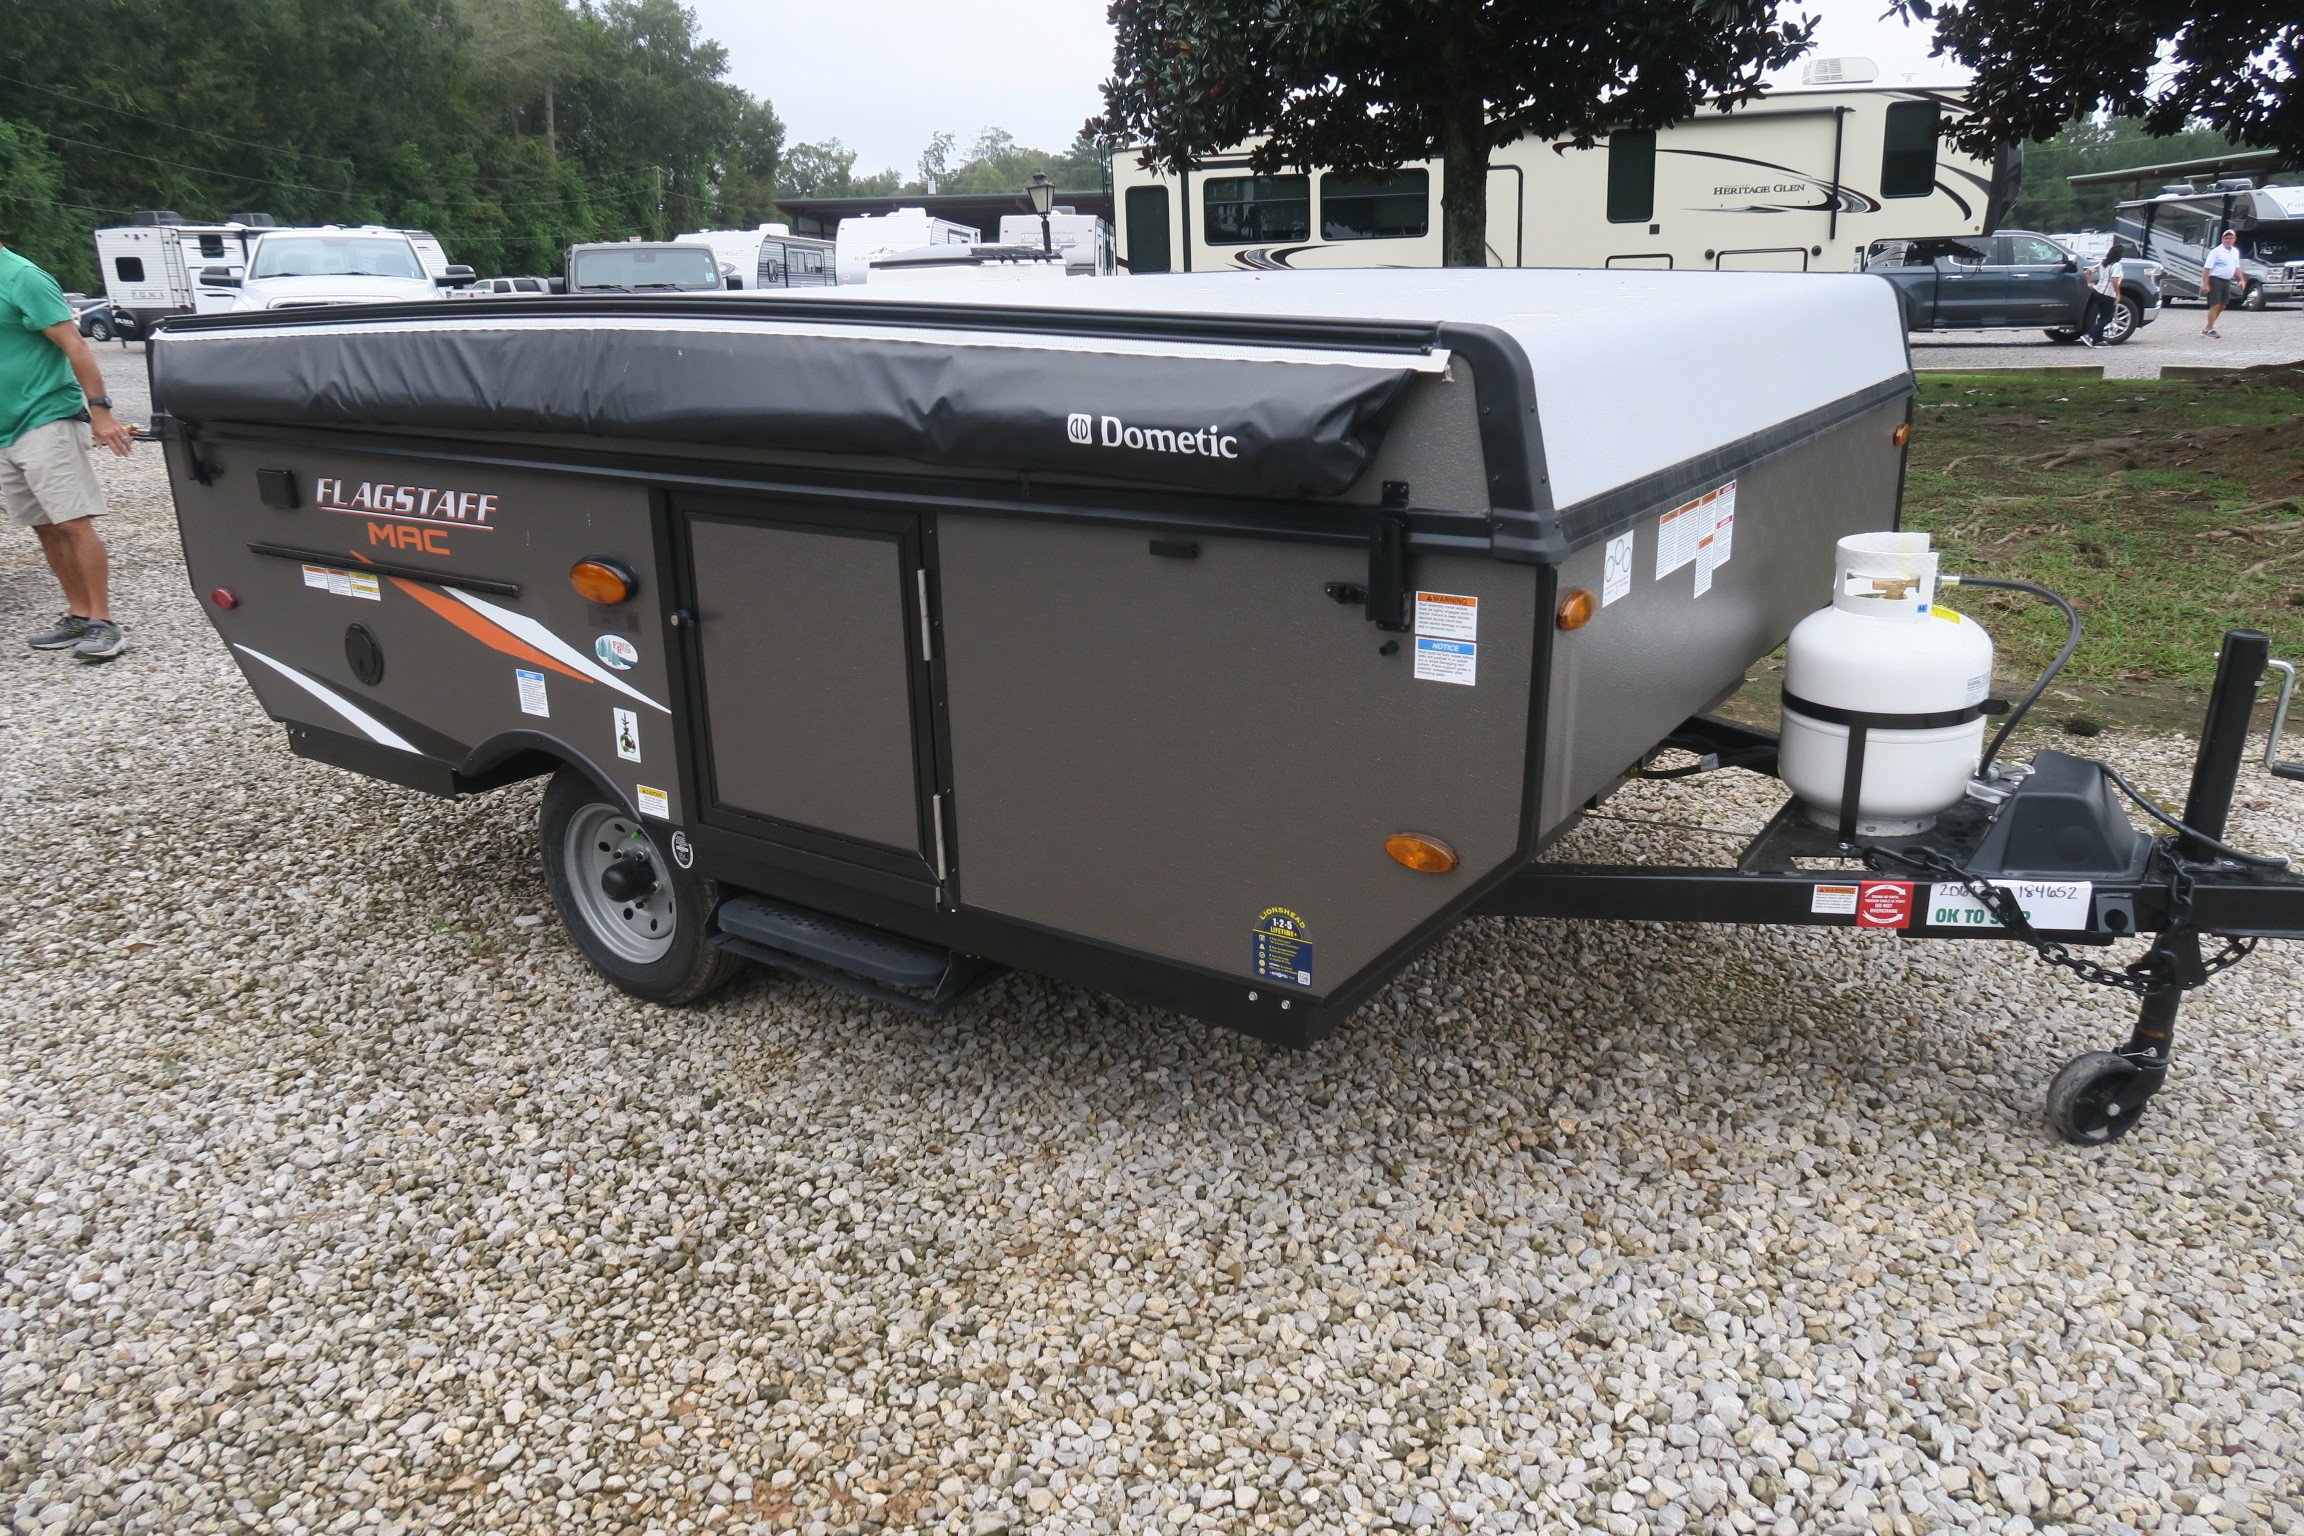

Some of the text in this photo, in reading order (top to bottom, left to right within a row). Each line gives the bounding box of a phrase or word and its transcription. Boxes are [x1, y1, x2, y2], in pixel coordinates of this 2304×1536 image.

[1713, 185, 1770, 195] HERITAGE
[1773, 184, 1805, 192] GLEN
[1101, 415, 1238, 459] Dometic
[316, 477, 498, 522] FLAGSTAFF
[367, 521, 450, 555] MAC
[1432, 642, 1460, 651] NOTICE
[2019, 885, 2078, 899] 184652
[1260, 907, 1305, 929] LIONSHEAD
[1935, 908, 2031, 924] OK TO SP
